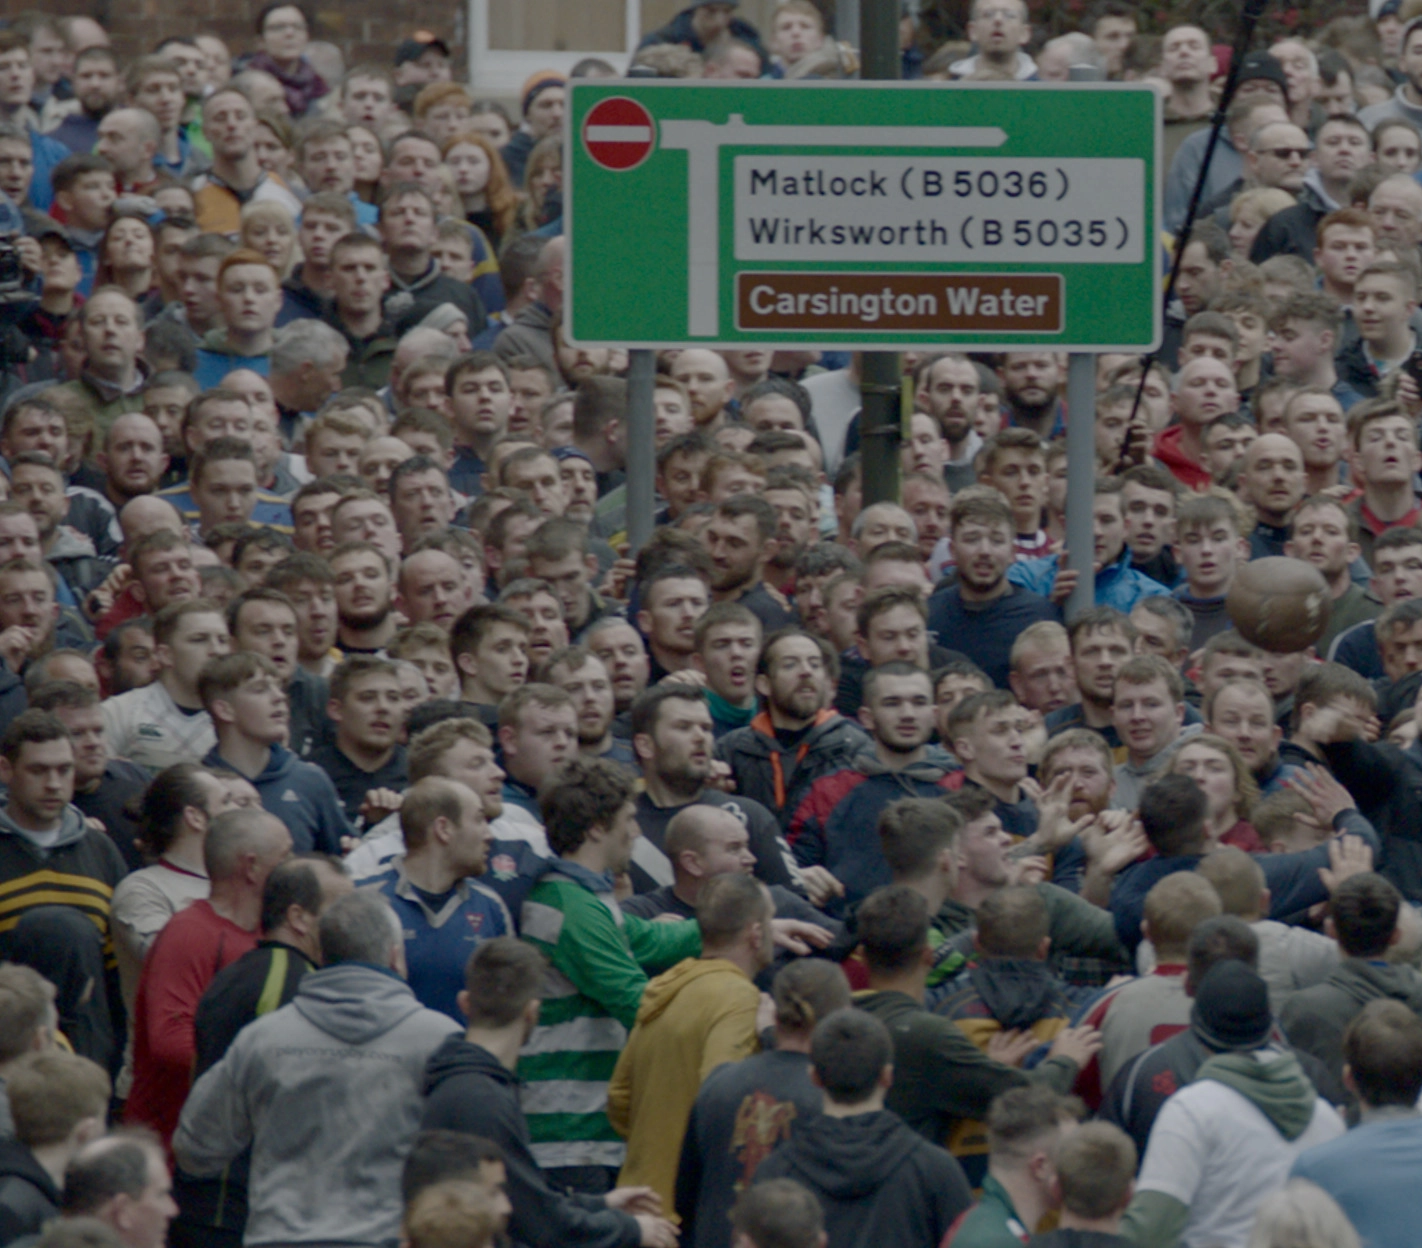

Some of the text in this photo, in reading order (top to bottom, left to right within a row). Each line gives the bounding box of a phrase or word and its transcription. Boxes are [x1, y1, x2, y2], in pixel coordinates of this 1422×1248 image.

[750, 168, 887, 197] Matlock
[748, 217, 948, 246] Wirksworth
[749, 284, 1049, 322] Carsington Water
